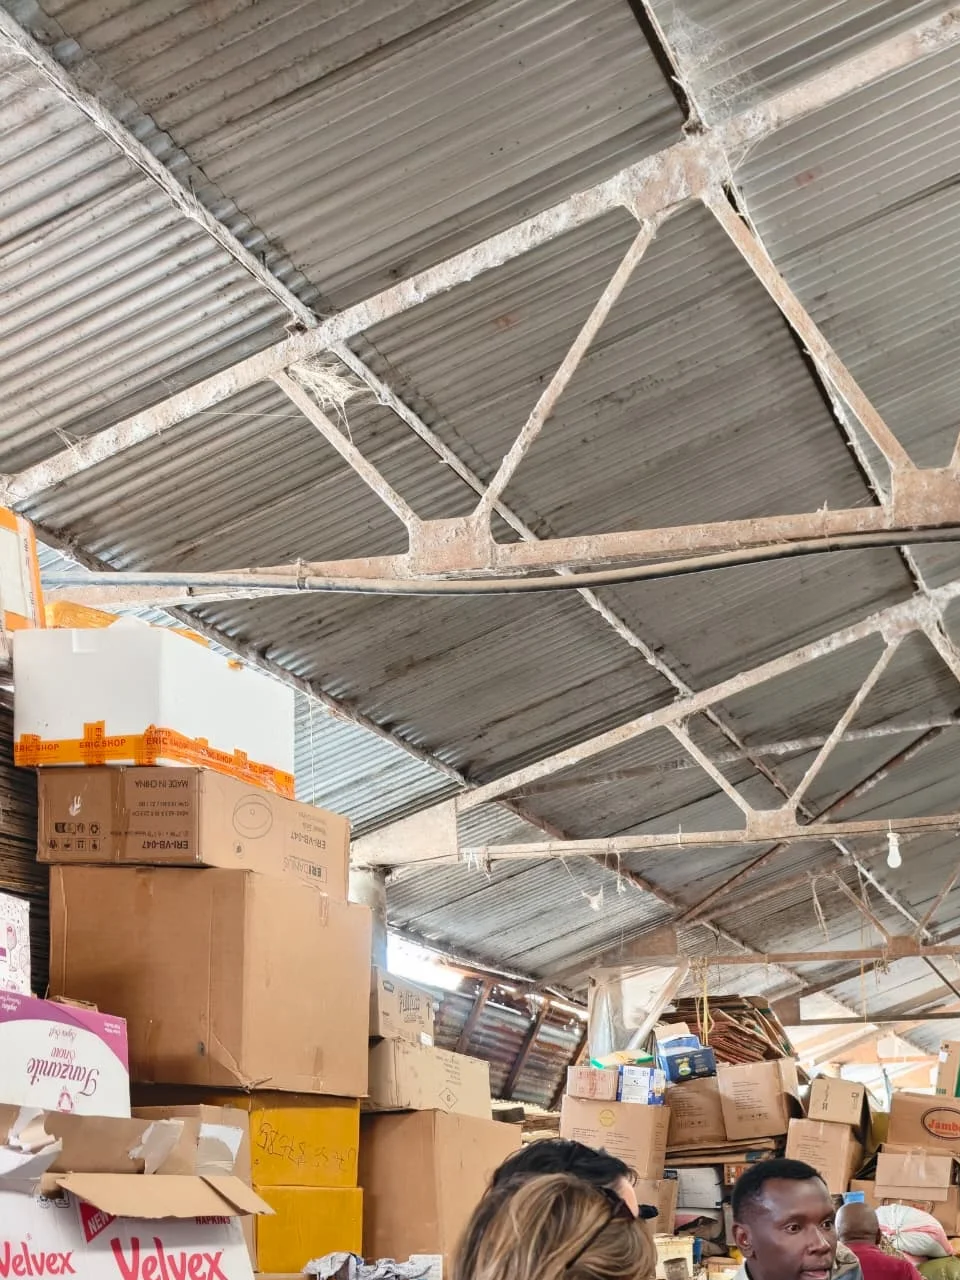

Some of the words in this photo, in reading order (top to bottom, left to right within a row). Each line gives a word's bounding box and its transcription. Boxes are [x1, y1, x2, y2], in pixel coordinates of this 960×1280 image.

[79, 740, 100, 749] ERIC
[102, 738, 127, 748] SHOP
[146, 736, 168, 745] ERIC
[36, 743, 60, 751] SHOP
[134, 780, 158, 789] CHINA
[159, 780, 167, 789] IN
[168, 779, 189, 789] MADE
[142, 840, 189, 850] ERI-VB-047
[290, 831, 327, 850] ERI-VB-047
[50, 1047, 76, 1065] Snow
[26, 1057, 99, 1097] Tanzanite
[87, 1211, 109, 1236] NEW
[0, 1241, 77, 1278] Velvex
